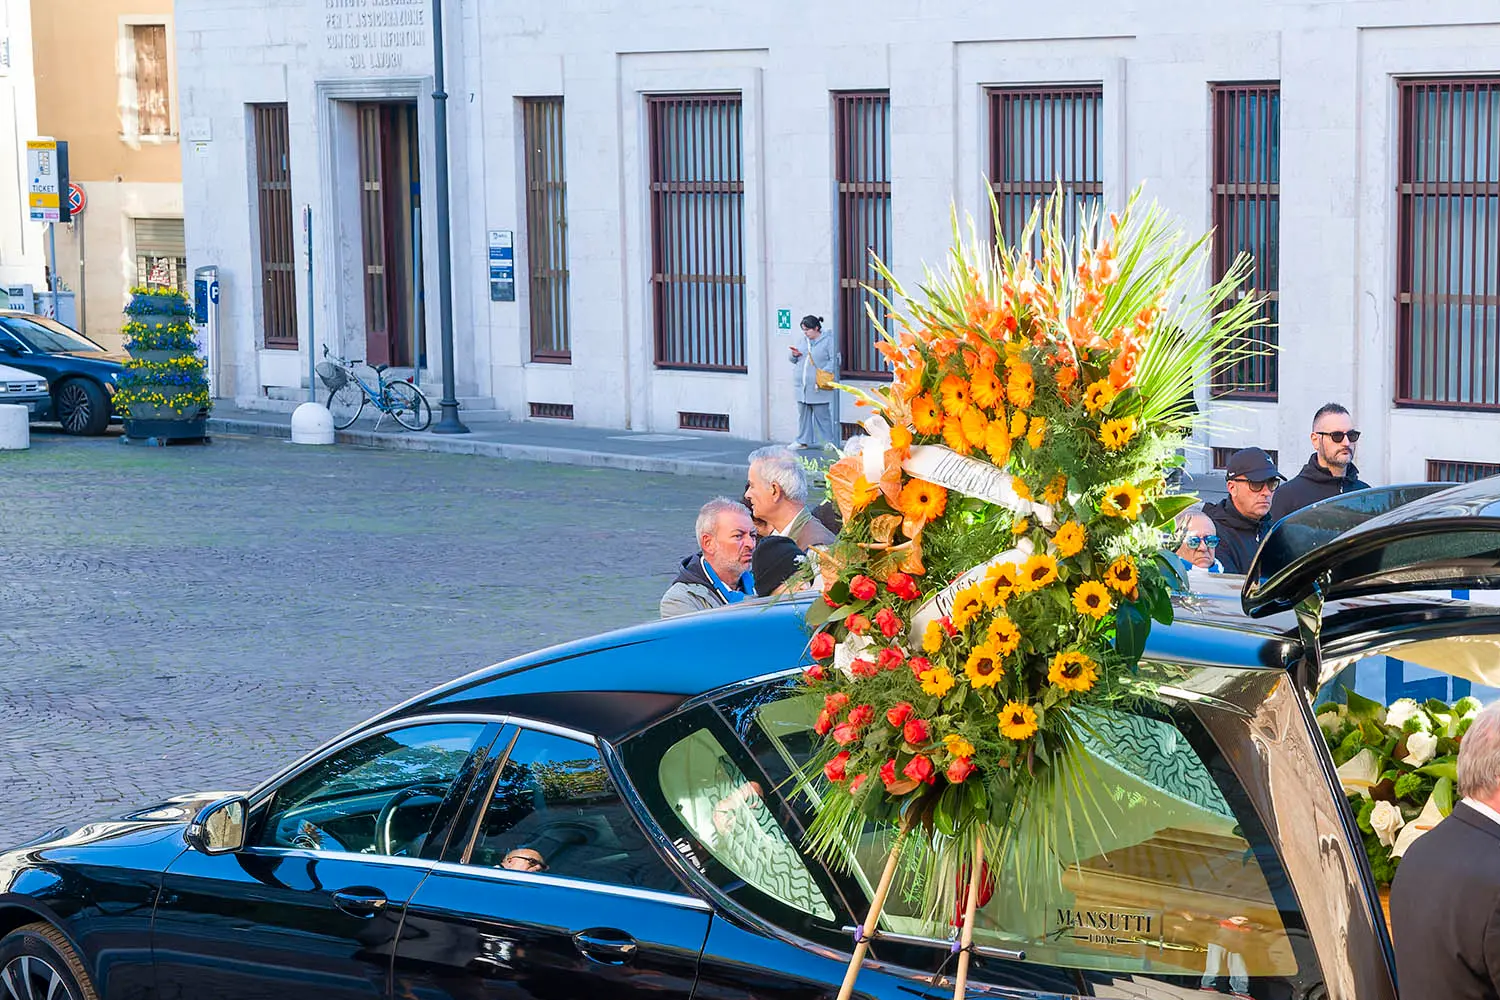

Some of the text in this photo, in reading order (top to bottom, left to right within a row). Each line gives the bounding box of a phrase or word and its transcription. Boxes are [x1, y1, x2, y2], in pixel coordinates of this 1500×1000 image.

[326, 32, 360, 49] CONTRO
[469, 93, 475, 103] 7
[32, 184, 54, 193] TICKET
[1056, 908, 1152, 933] MANSUTTI
[1089, 933, 1118, 945] UDINE
